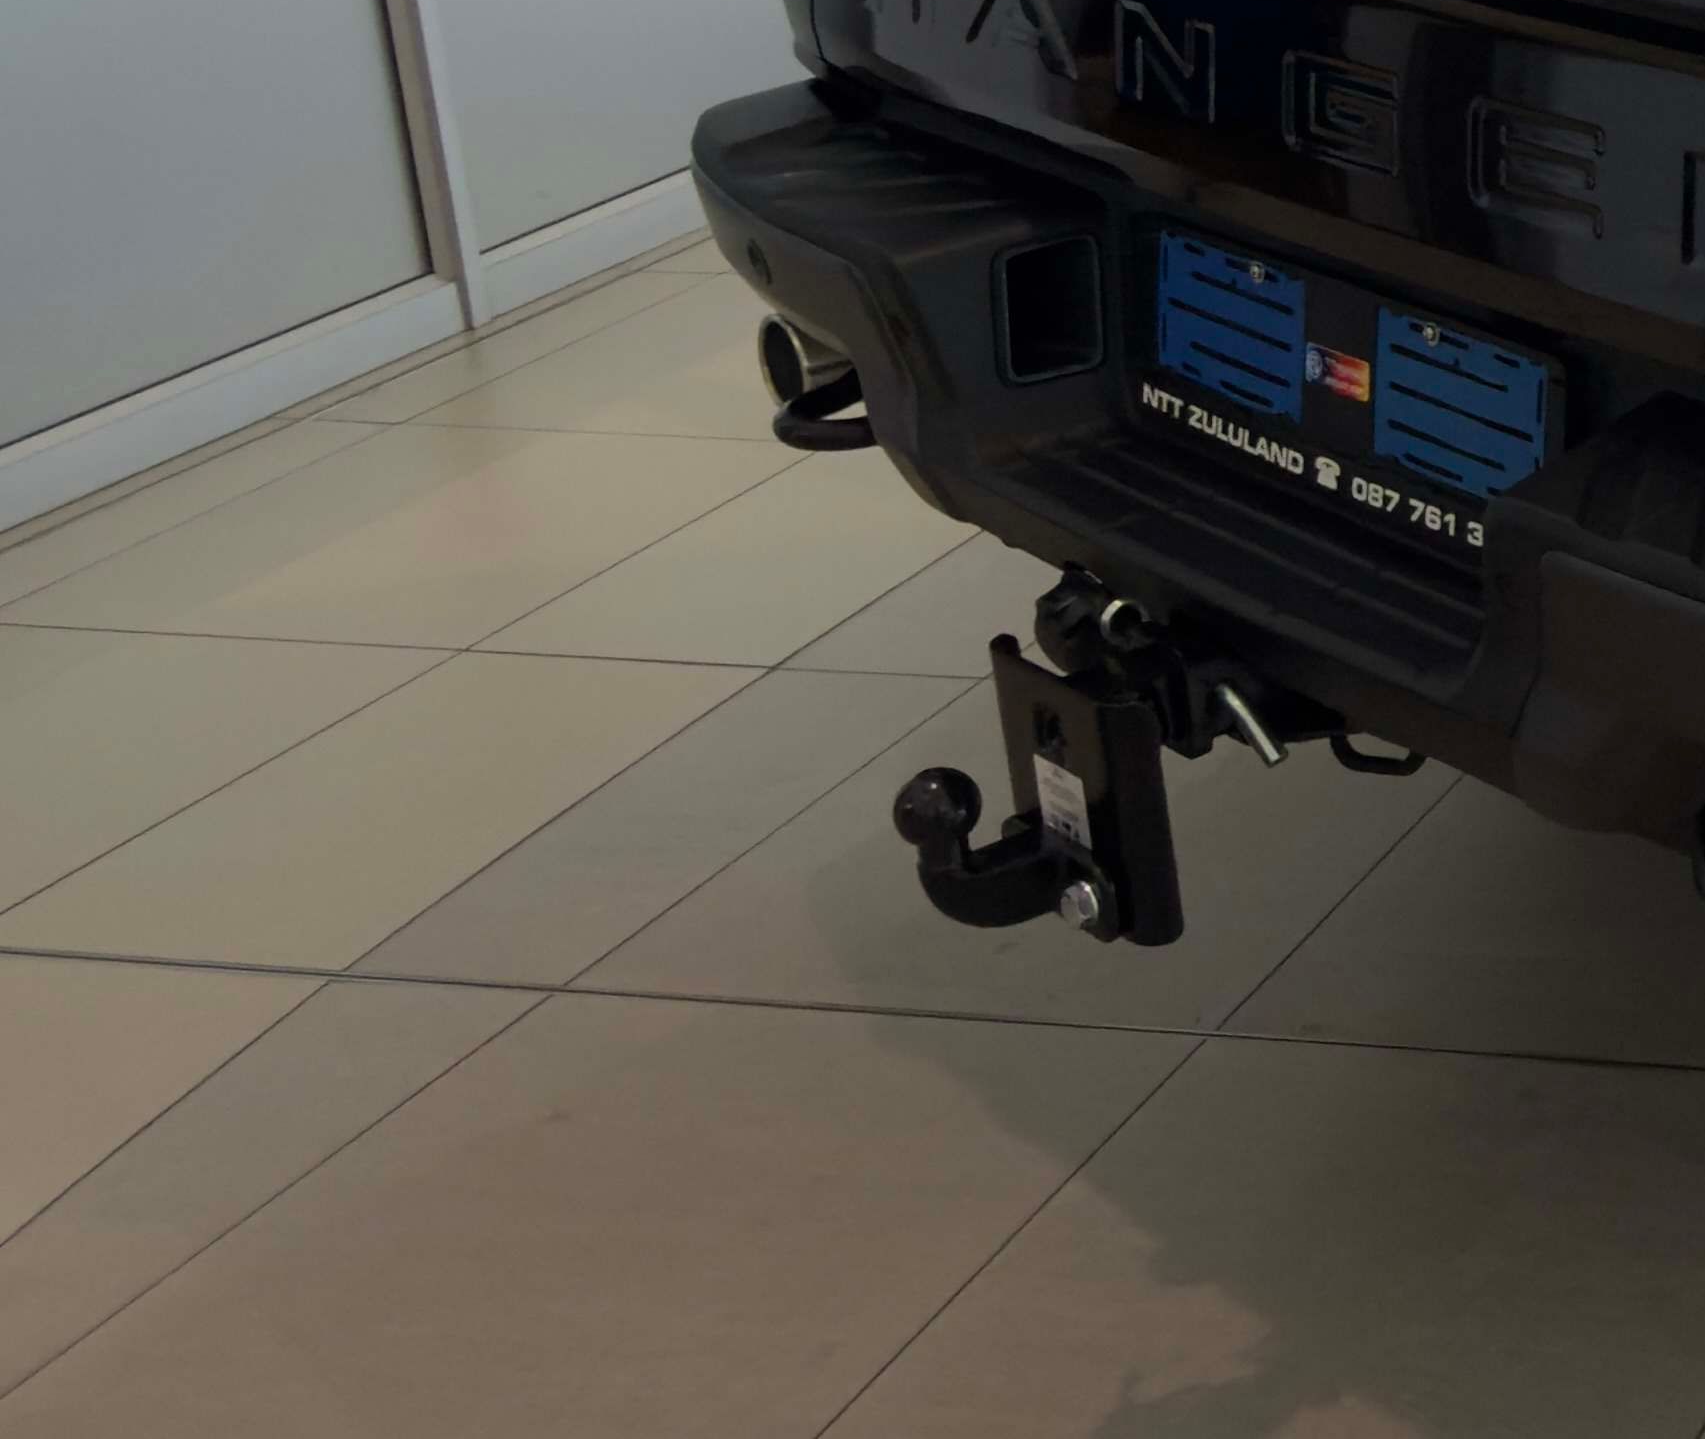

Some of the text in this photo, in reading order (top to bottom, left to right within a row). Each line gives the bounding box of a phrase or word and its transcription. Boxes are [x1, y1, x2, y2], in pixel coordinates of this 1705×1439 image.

[1142, 382, 1184, 419] NTT
[1188, 404, 1305, 476] ZULULAND
[1351, 476, 1401, 513] 087
[1408, 497, 1457, 537] 761
